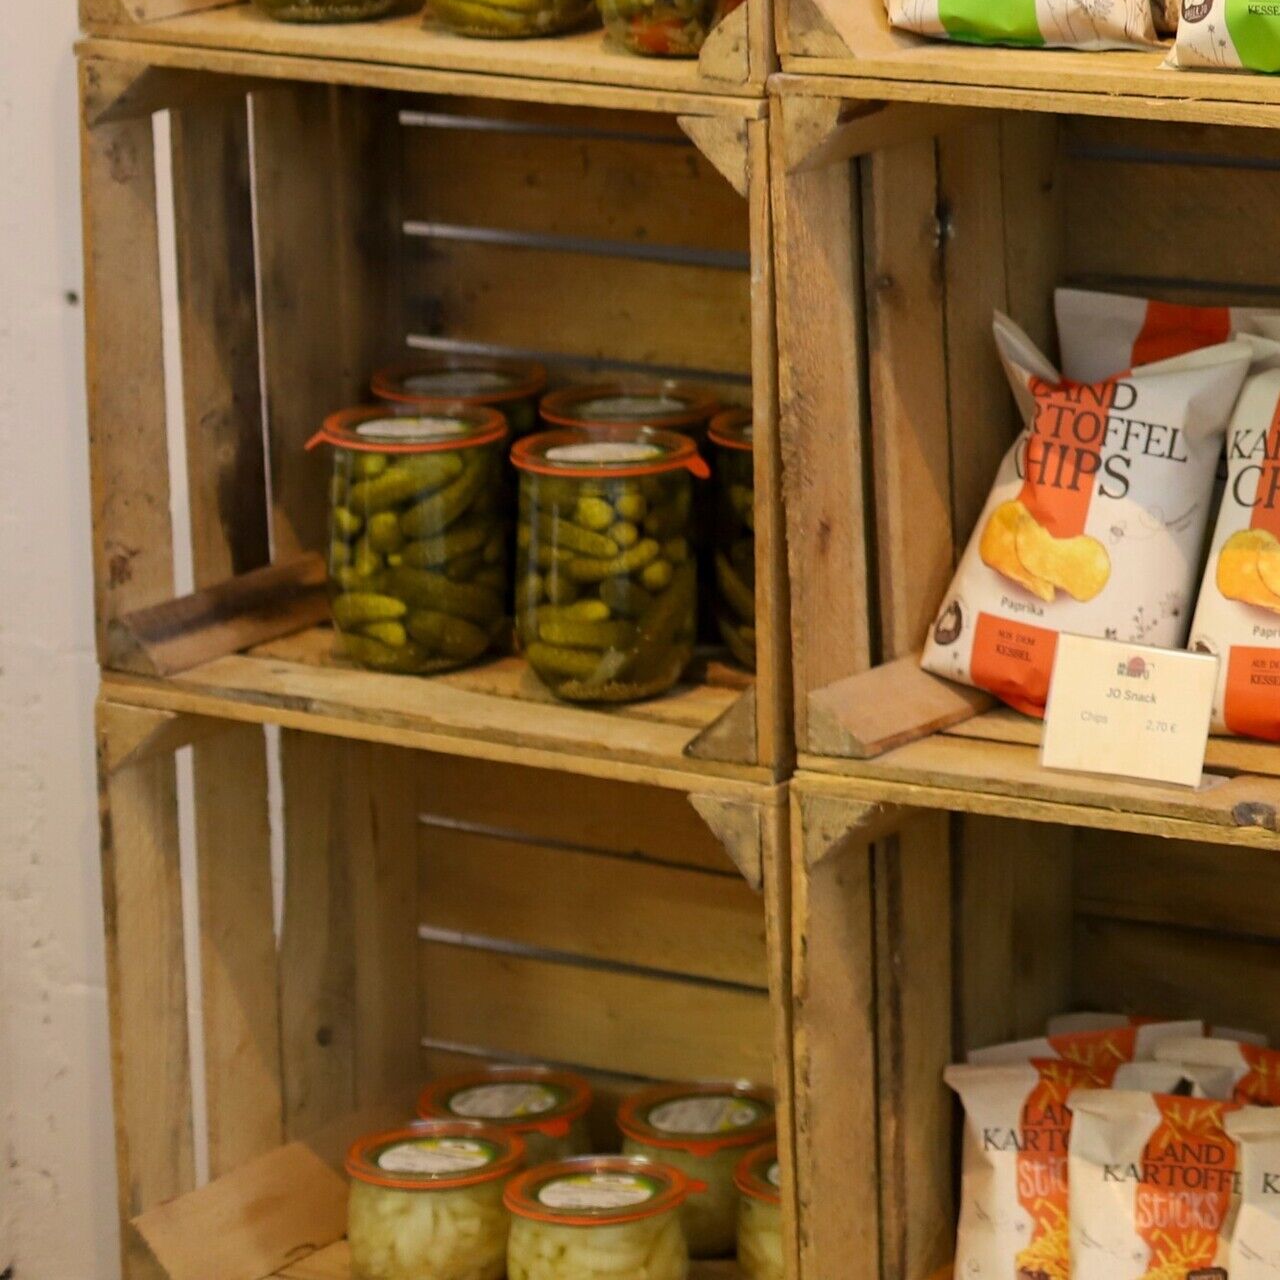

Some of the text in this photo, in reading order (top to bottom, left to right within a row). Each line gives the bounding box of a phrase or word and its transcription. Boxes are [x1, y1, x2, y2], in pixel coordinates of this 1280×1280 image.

[1001, 595, 1044, 616] Paprika
[1106, 688, 1157, 704] JO Snack
[1081, 711, 1177, 733] Chips 2,70 €
[1144, 1143, 1225, 1165] LAND
[1102, 1163, 1242, 1195] KARTOFFE
